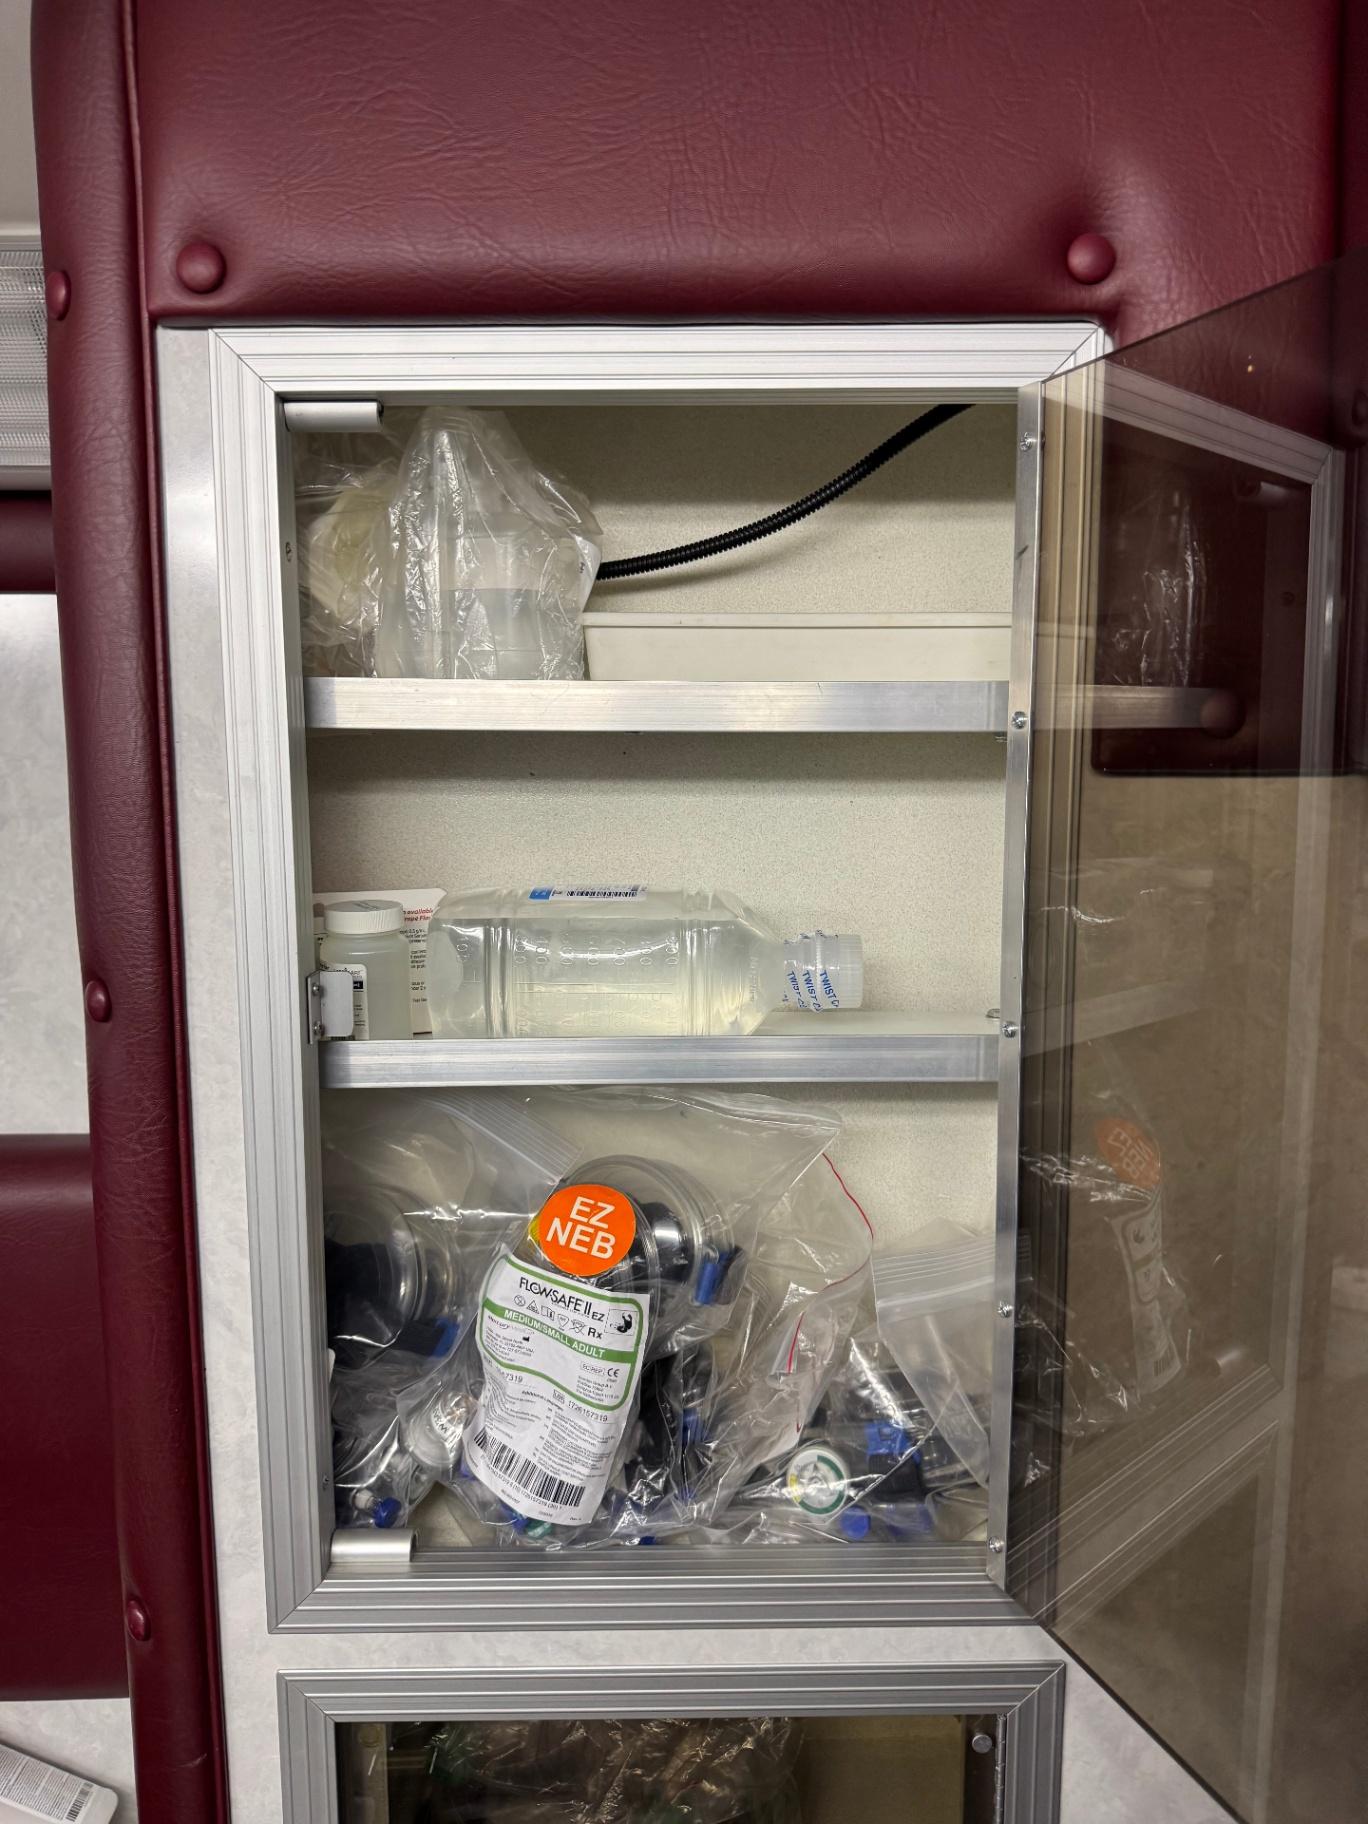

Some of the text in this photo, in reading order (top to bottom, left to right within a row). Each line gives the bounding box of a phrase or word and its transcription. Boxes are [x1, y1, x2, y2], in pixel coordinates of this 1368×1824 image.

[802, 969, 818, 1002] TWIST
[819, 969, 837, 999] TWIST
[569, 1196, 615, 1229] EZ
[545, 1217, 616, 1259] NEB
[503, 1309, 574, 1348] MEDIUM/SMALL
[572, 1341, 607, 1358] ADULT
[587, 1326, 603, 1340] Rx
[592, 1311, 606, 1323] EZ
